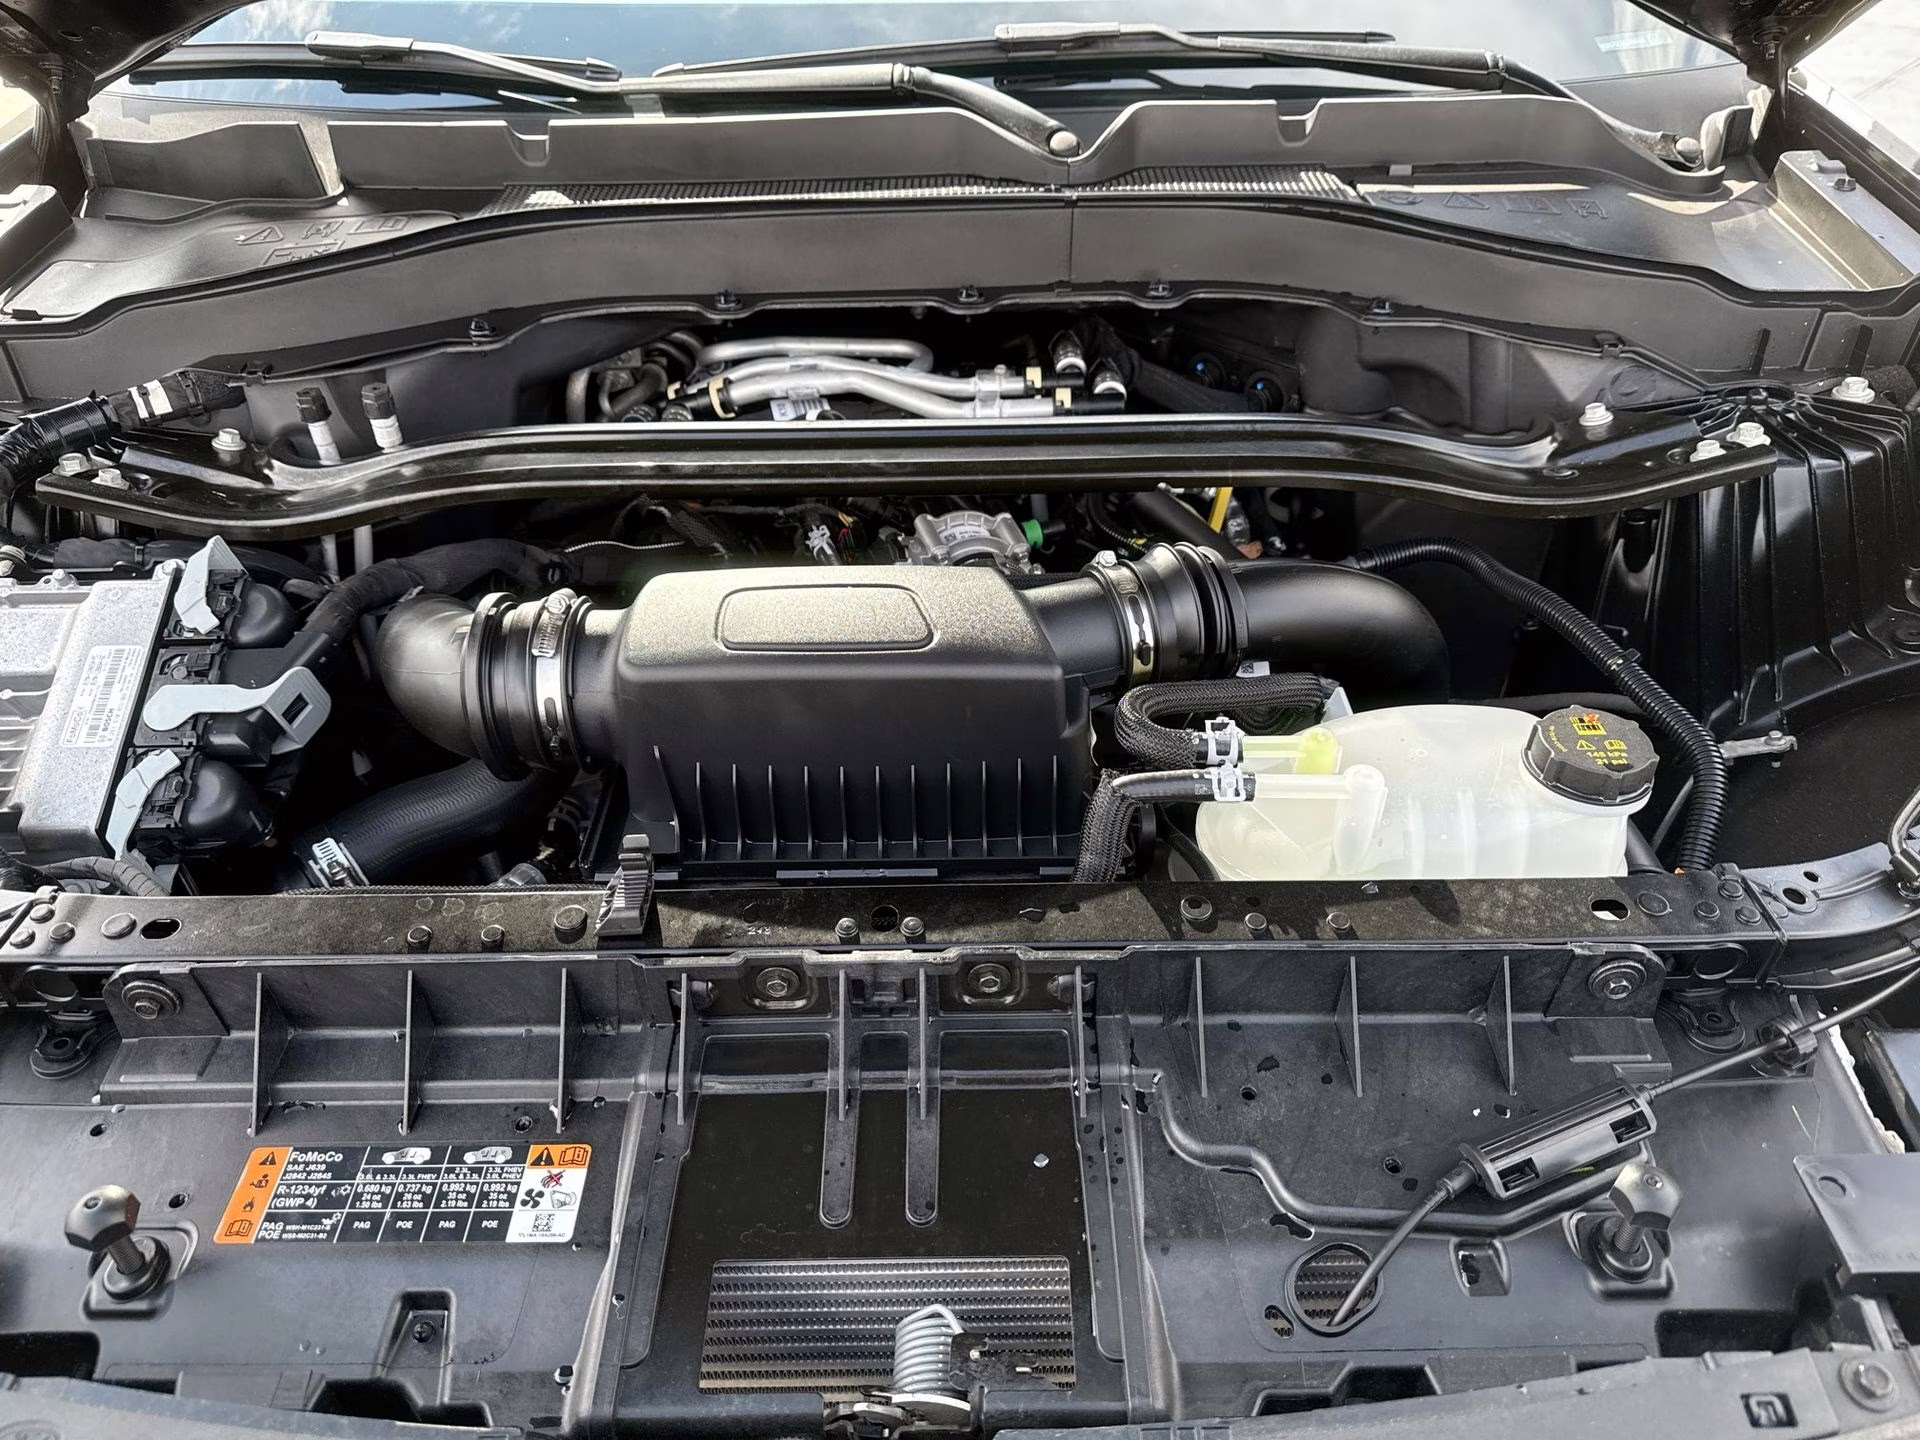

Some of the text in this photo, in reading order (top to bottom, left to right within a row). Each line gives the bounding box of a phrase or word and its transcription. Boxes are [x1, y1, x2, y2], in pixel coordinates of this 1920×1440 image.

[102, 708, 115, 732] BOSCH
[289, 1151, 344, 1162] FoMoCo
[276, 1185, 327, 1197] R-1234yf
[357, 1183, 392, 1194] 0.680 kg
[397, 1183, 433, 1194] 0.737 kg
[442, 1183, 477, 1193] 0.992 kg
[482, 1183, 518, 1193] 0.992 kg
[447, 1192, 457, 1200] 35
[488, 1192, 498, 1200] 35
[271, 1197, 318, 1208] (GWP 4)
[261, 1221, 284, 1230] PAG
[353, 1221, 371, 1229] PAG
[396, 1221, 414, 1229] POE
[438, 1220, 456, 1228] PAG
[481, 1220, 499, 1228] POE
[258, 1230, 281, 1239] POE
